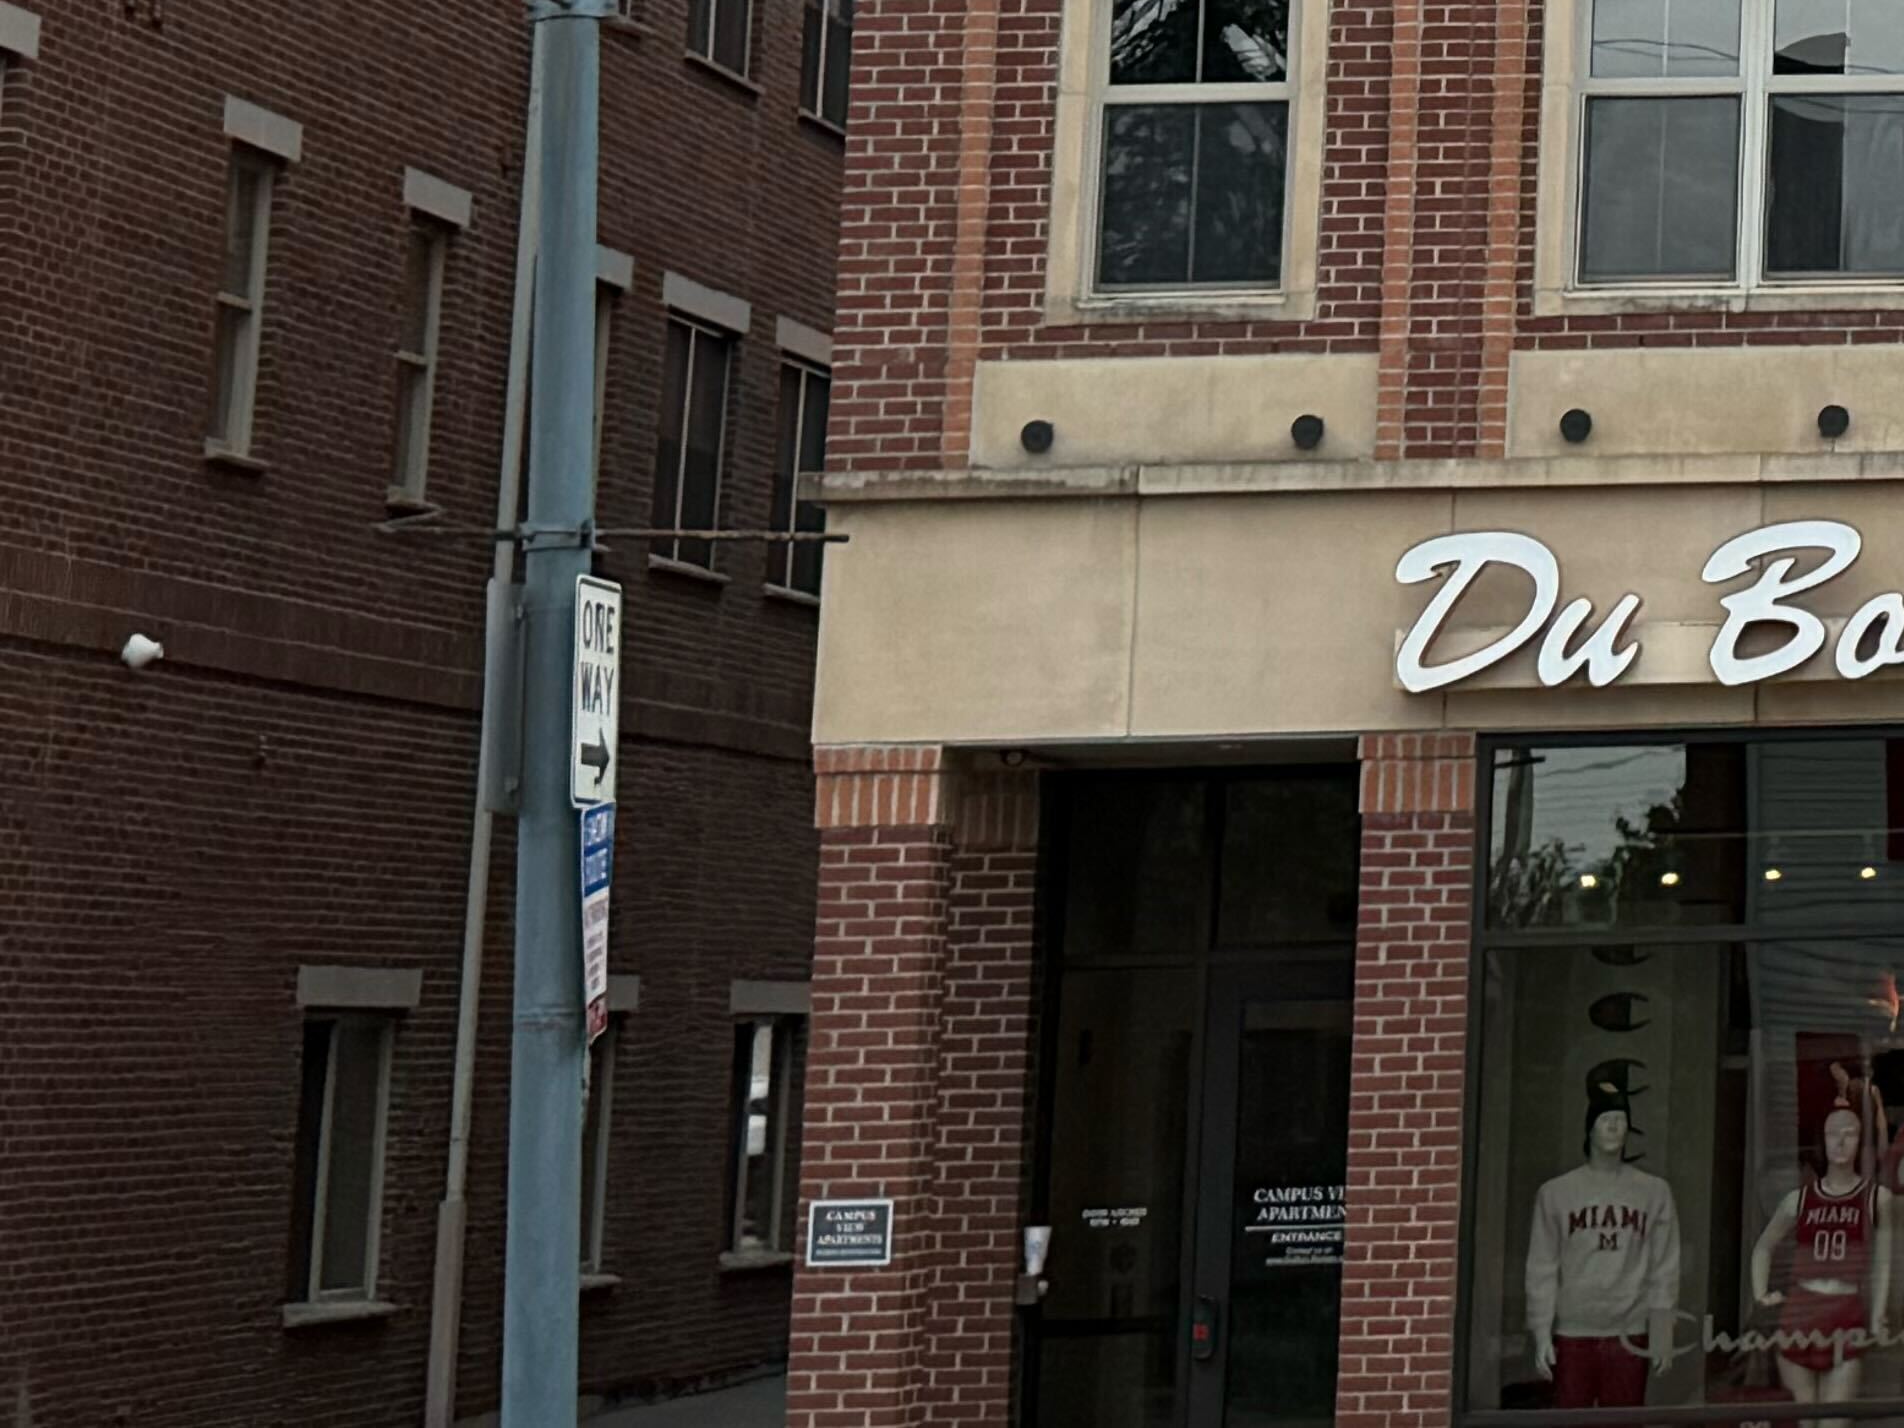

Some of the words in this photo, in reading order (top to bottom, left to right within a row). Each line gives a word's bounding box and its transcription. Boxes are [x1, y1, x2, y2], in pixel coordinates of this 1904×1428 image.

[1394, 529, 1641, 695] Du
[582, 599, 615, 654] ONE
[580, 661, 615, 716] WAY
[1253, 1185, 1325, 1203] CAMPUS
[1327, 1185, 1344, 1201] VI
[825, 1209, 877, 1222] CAMPUS
[1256, 1205, 1346, 1222] APARTMEN
[1568, 1204, 1648, 1240] MIAMI
[1805, 1206, 1861, 1225] MIAMI
[1270, 1231, 1343, 1244] ENTRANCE
[1598, 1231, 1618, 1251] M
